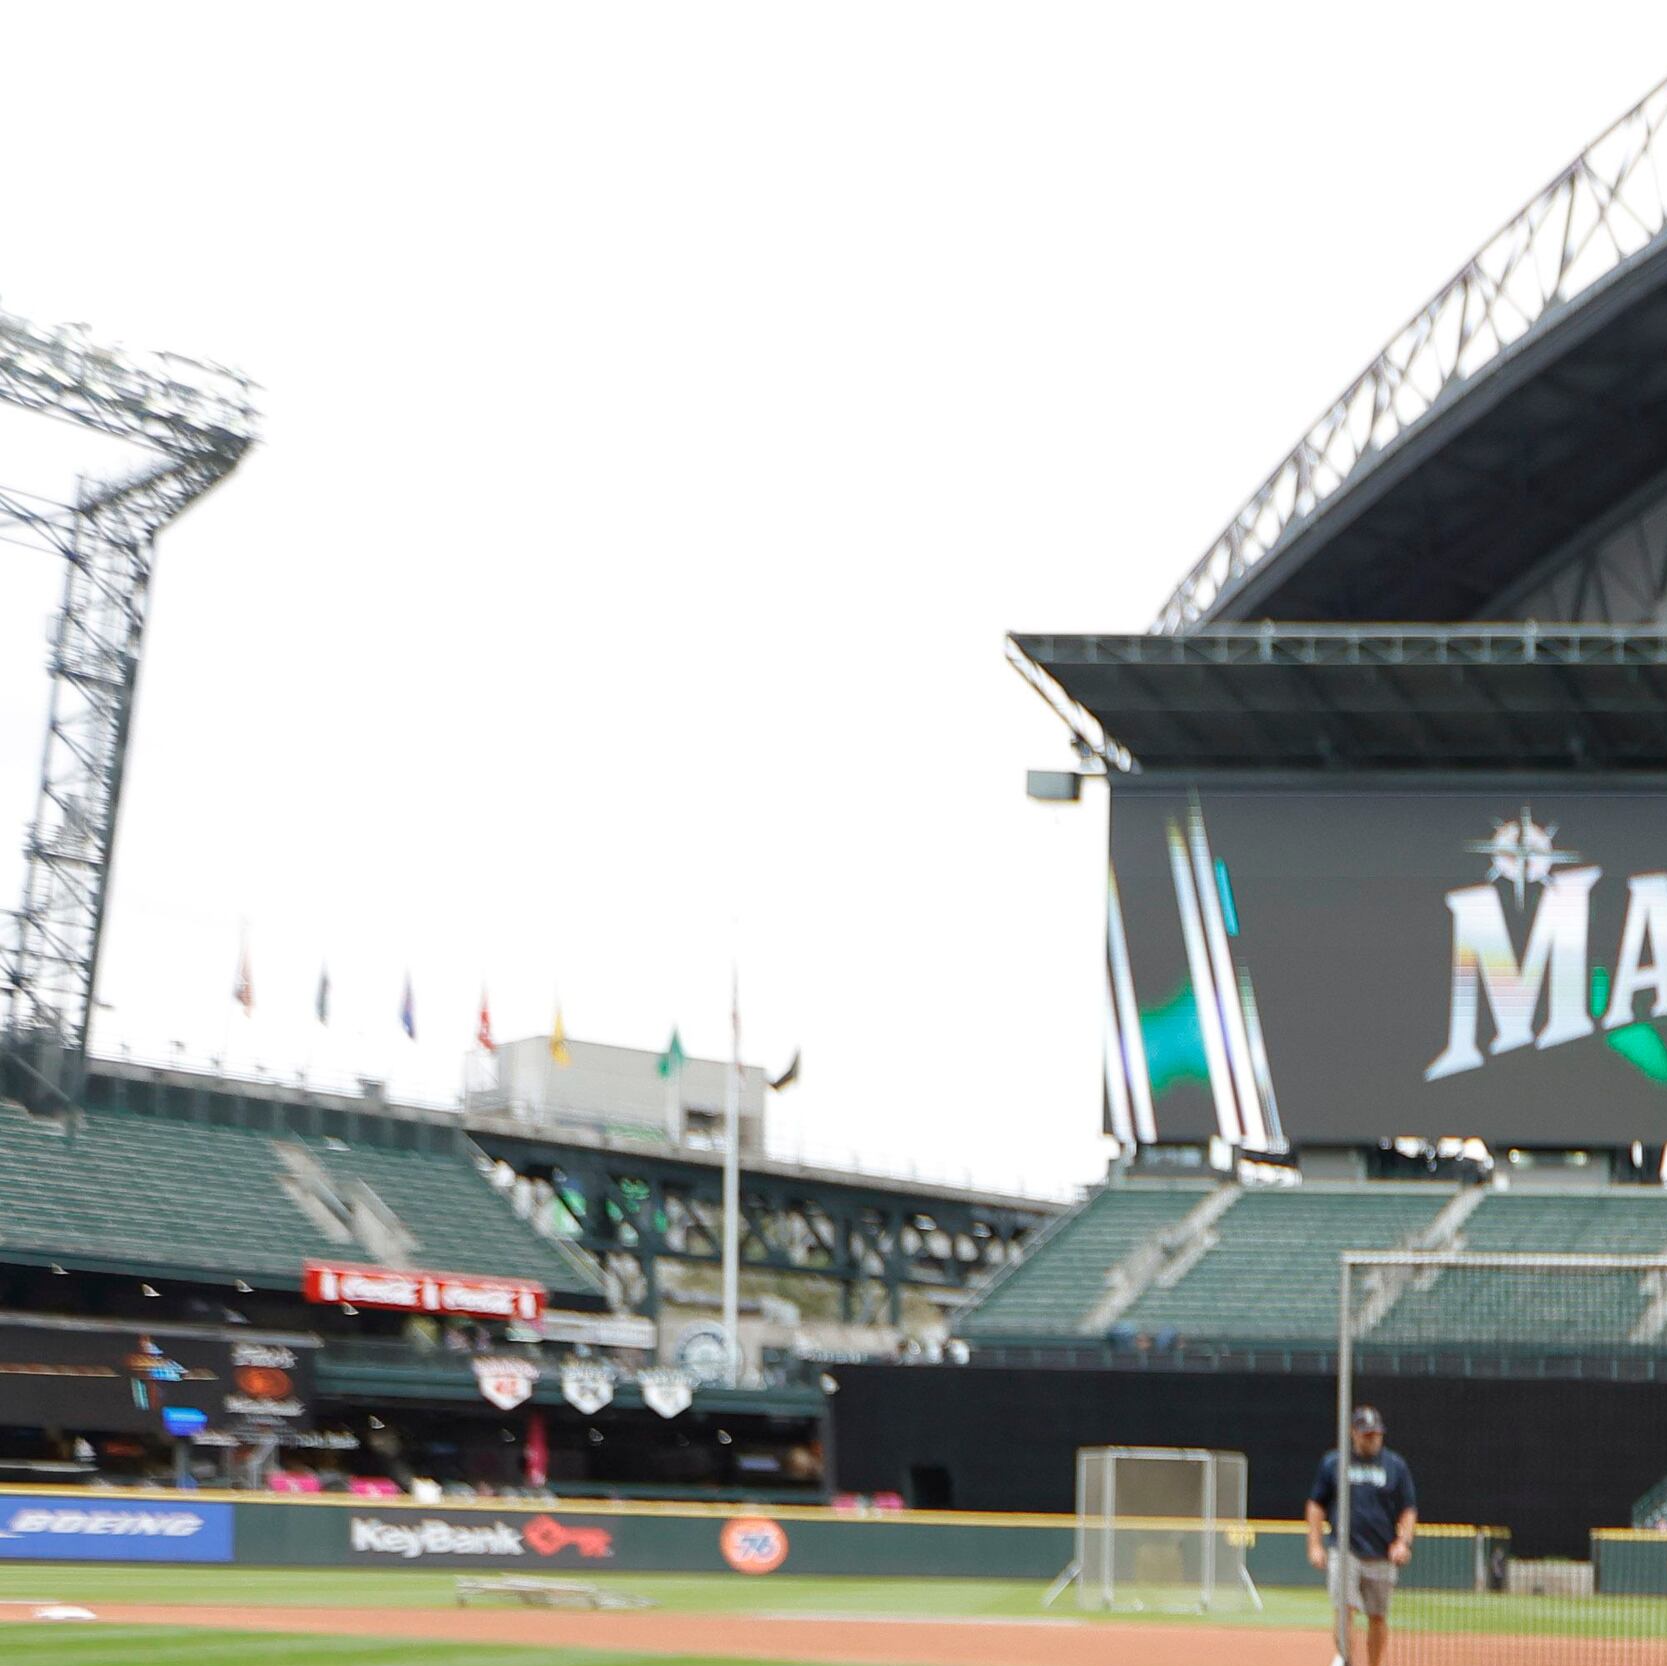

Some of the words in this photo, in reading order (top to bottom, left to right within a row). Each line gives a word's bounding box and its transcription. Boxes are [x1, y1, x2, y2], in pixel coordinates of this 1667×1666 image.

[10, 1508, 205, 1537] BOEING
[351, 1517, 526, 1558] KeyBank
[741, 1532, 777, 1558] 76
